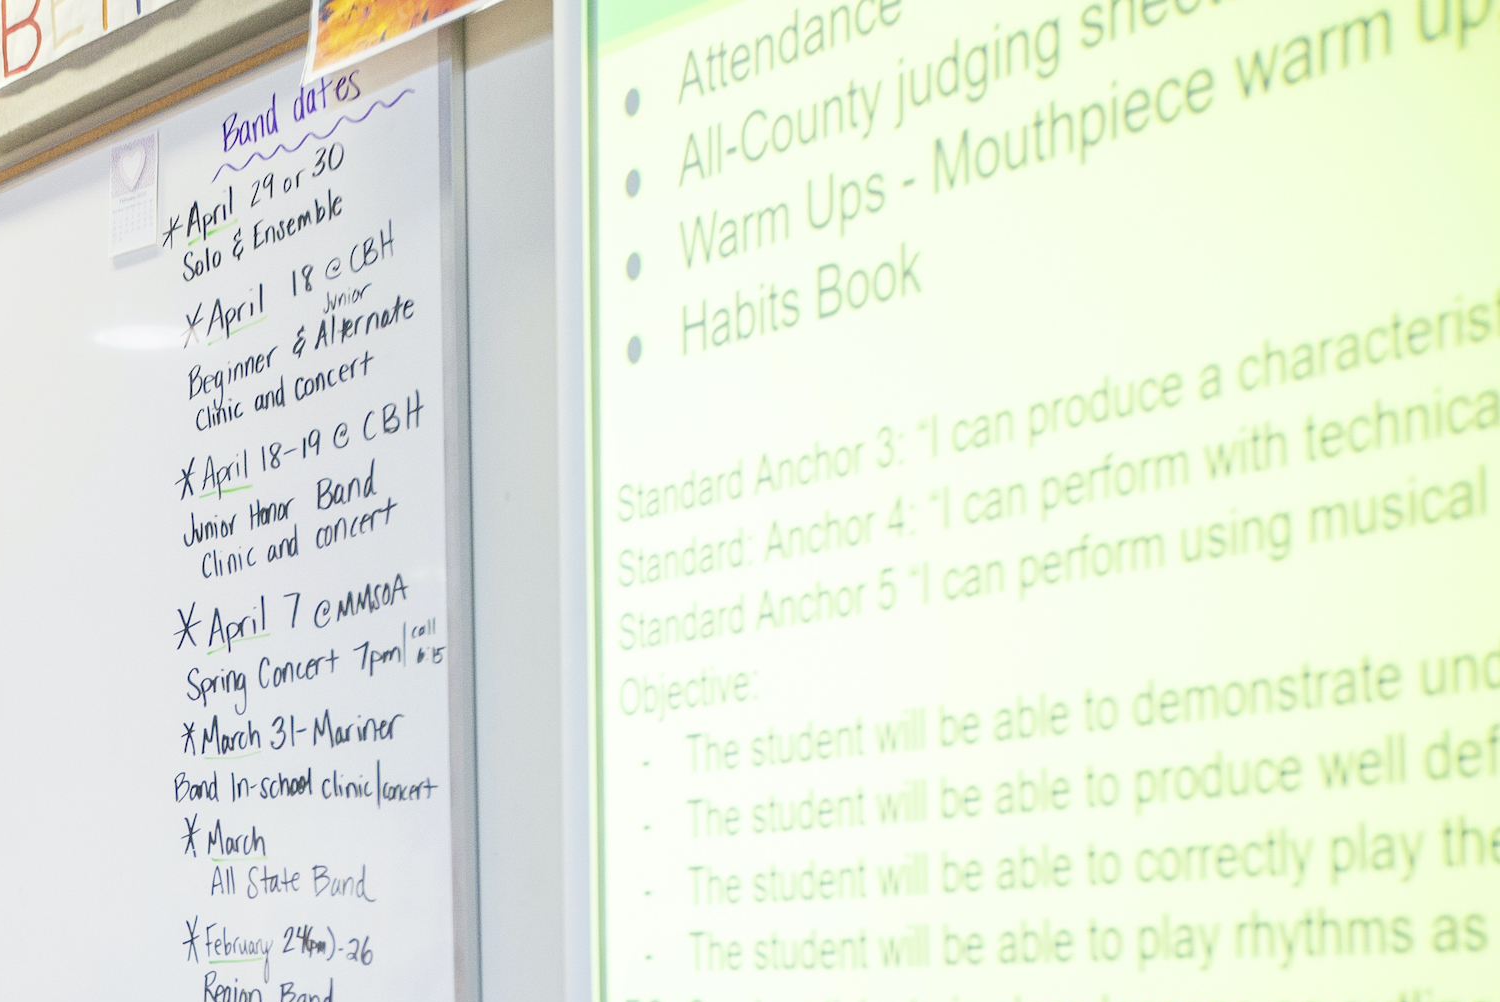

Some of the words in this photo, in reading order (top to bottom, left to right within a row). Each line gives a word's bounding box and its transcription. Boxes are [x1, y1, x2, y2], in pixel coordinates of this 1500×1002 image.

[678, 0, 902, 105] Attendance
[222, 94, 278, 152] Band
[293, 69, 362, 123] dates
[679, 79, 882, 188] All-County
[895, 18, 1060, 129] judging
[679, 201, 790, 270] Warm
[806, 172, 886, 238] Ups
[933, 67, 1214, 194] Mouthpiece
[1234, 9, 1393, 99] warm
[183, 246, 222, 282] Solo
[233, 228, 244, 261] &
[253, 189, 343, 250] Ensemble
[187, 187, 234, 241] April
[250, 173, 274, 207] 29
[283, 170, 305, 193] or
[312, 141, 344, 179] 30
[206, 283, 264, 339] April
[292, 265, 313, 297] 18
[325, 257, 342, 280] @
[350, 218, 395, 274] CBH
[323, 283, 372, 314] Junior
[683, 281, 800, 356] Habits
[817, 240, 922, 320] Book
[188, 345, 279, 409] Beginner
[292, 325, 306, 359] &
[315, 294, 415, 350] Alternate
[254, 375, 286, 410] and
[202, 449, 249, 500] April
[261, 428, 321, 472] 18-19
[333, 422, 350, 449] @
[363, 388, 425, 441] CBH
[618, 459, 745, 522] Standard
[754, 441, 867, 496] Anchor
[876, 425, 905, 468] 3:
[951, 408, 1015, 452] can
[1029, 371, 1184, 448] produce
[1199, 362, 1223, 401] a
[183, 511, 237, 547] Junior
[249, 497, 296, 531] Honor
[316, 458, 378, 510] Band
[202, 546, 256, 579] Clinic
[267, 523, 299, 559] and
[315, 496, 399, 549] concert
[618, 527, 754, 588] Standard:
[764, 510, 877, 562] Anchor
[887, 496, 916, 538] 4:
[963, 480, 1027, 525] can
[1041, 452, 1190, 522] perform
[1205, 421, 1288, 480] with
[619, 593, 746, 651] Standard
[756, 580, 868, 630] Anchor
[878, 568, 899, 611] 5
[943, 559, 1006, 600] can
[1019, 533, 1166, 600] perform
[1180, 507, 1292, 562] using
[1310, 463, 1488, 543] musical
[208, 595, 266, 653] April
[283, 592, 302, 628] 7
[186, 667, 248, 715] Spring
[201, 714, 261, 755] March
[619, 667, 760, 722] Objective:
[686, 733, 741, 773] The
[750, 716, 865, 767] student
[875, 706, 927, 754] will
[940, 704, 981, 748] be
[992, 692, 1070, 742] able
[1085, 687, 1119, 732] to
[1131, 655, 1402, 727] demonstrate
[174, 770, 220, 803] Band
[231, 767, 313, 803] In-school
[686, 798, 741, 838] The
[751, 784, 866, 834] student
[875, 777, 928, 825] will
[940, 775, 983, 820] be
[994, 767, 1071, 813] able
[1086, 765, 1121, 807] to
[1134, 750, 1303, 816] produce
[1318, 732, 1407, 788] well
[207, 818, 266, 856] March
[687, 865, 742, 906] The
[752, 858, 867, 903] student
[877, 850, 930, 897] will
[941, 850, 984, 894] be
[996, 842, 1073, 889] able
[1087, 842, 1122, 887] to
[1134, 826, 1315, 888] correctly
[1330, 821, 1426, 887] play
[211, 865, 236, 896] All
[247, 864, 301, 899] State
[312, 864, 377, 902] Band
[205, 922, 274, 984] February
[688, 931, 744, 971] The
[754, 926, 869, 970] student
[878, 922, 932, 968] will
[941, 922, 986, 966] be
[997, 916, 1075, 963] able
[1088, 917, 1123, 961] to
[1137, 911, 1221, 972] play
[1234, 907, 1415, 970] rhythms
[1430, 911, 1489, 954] as
